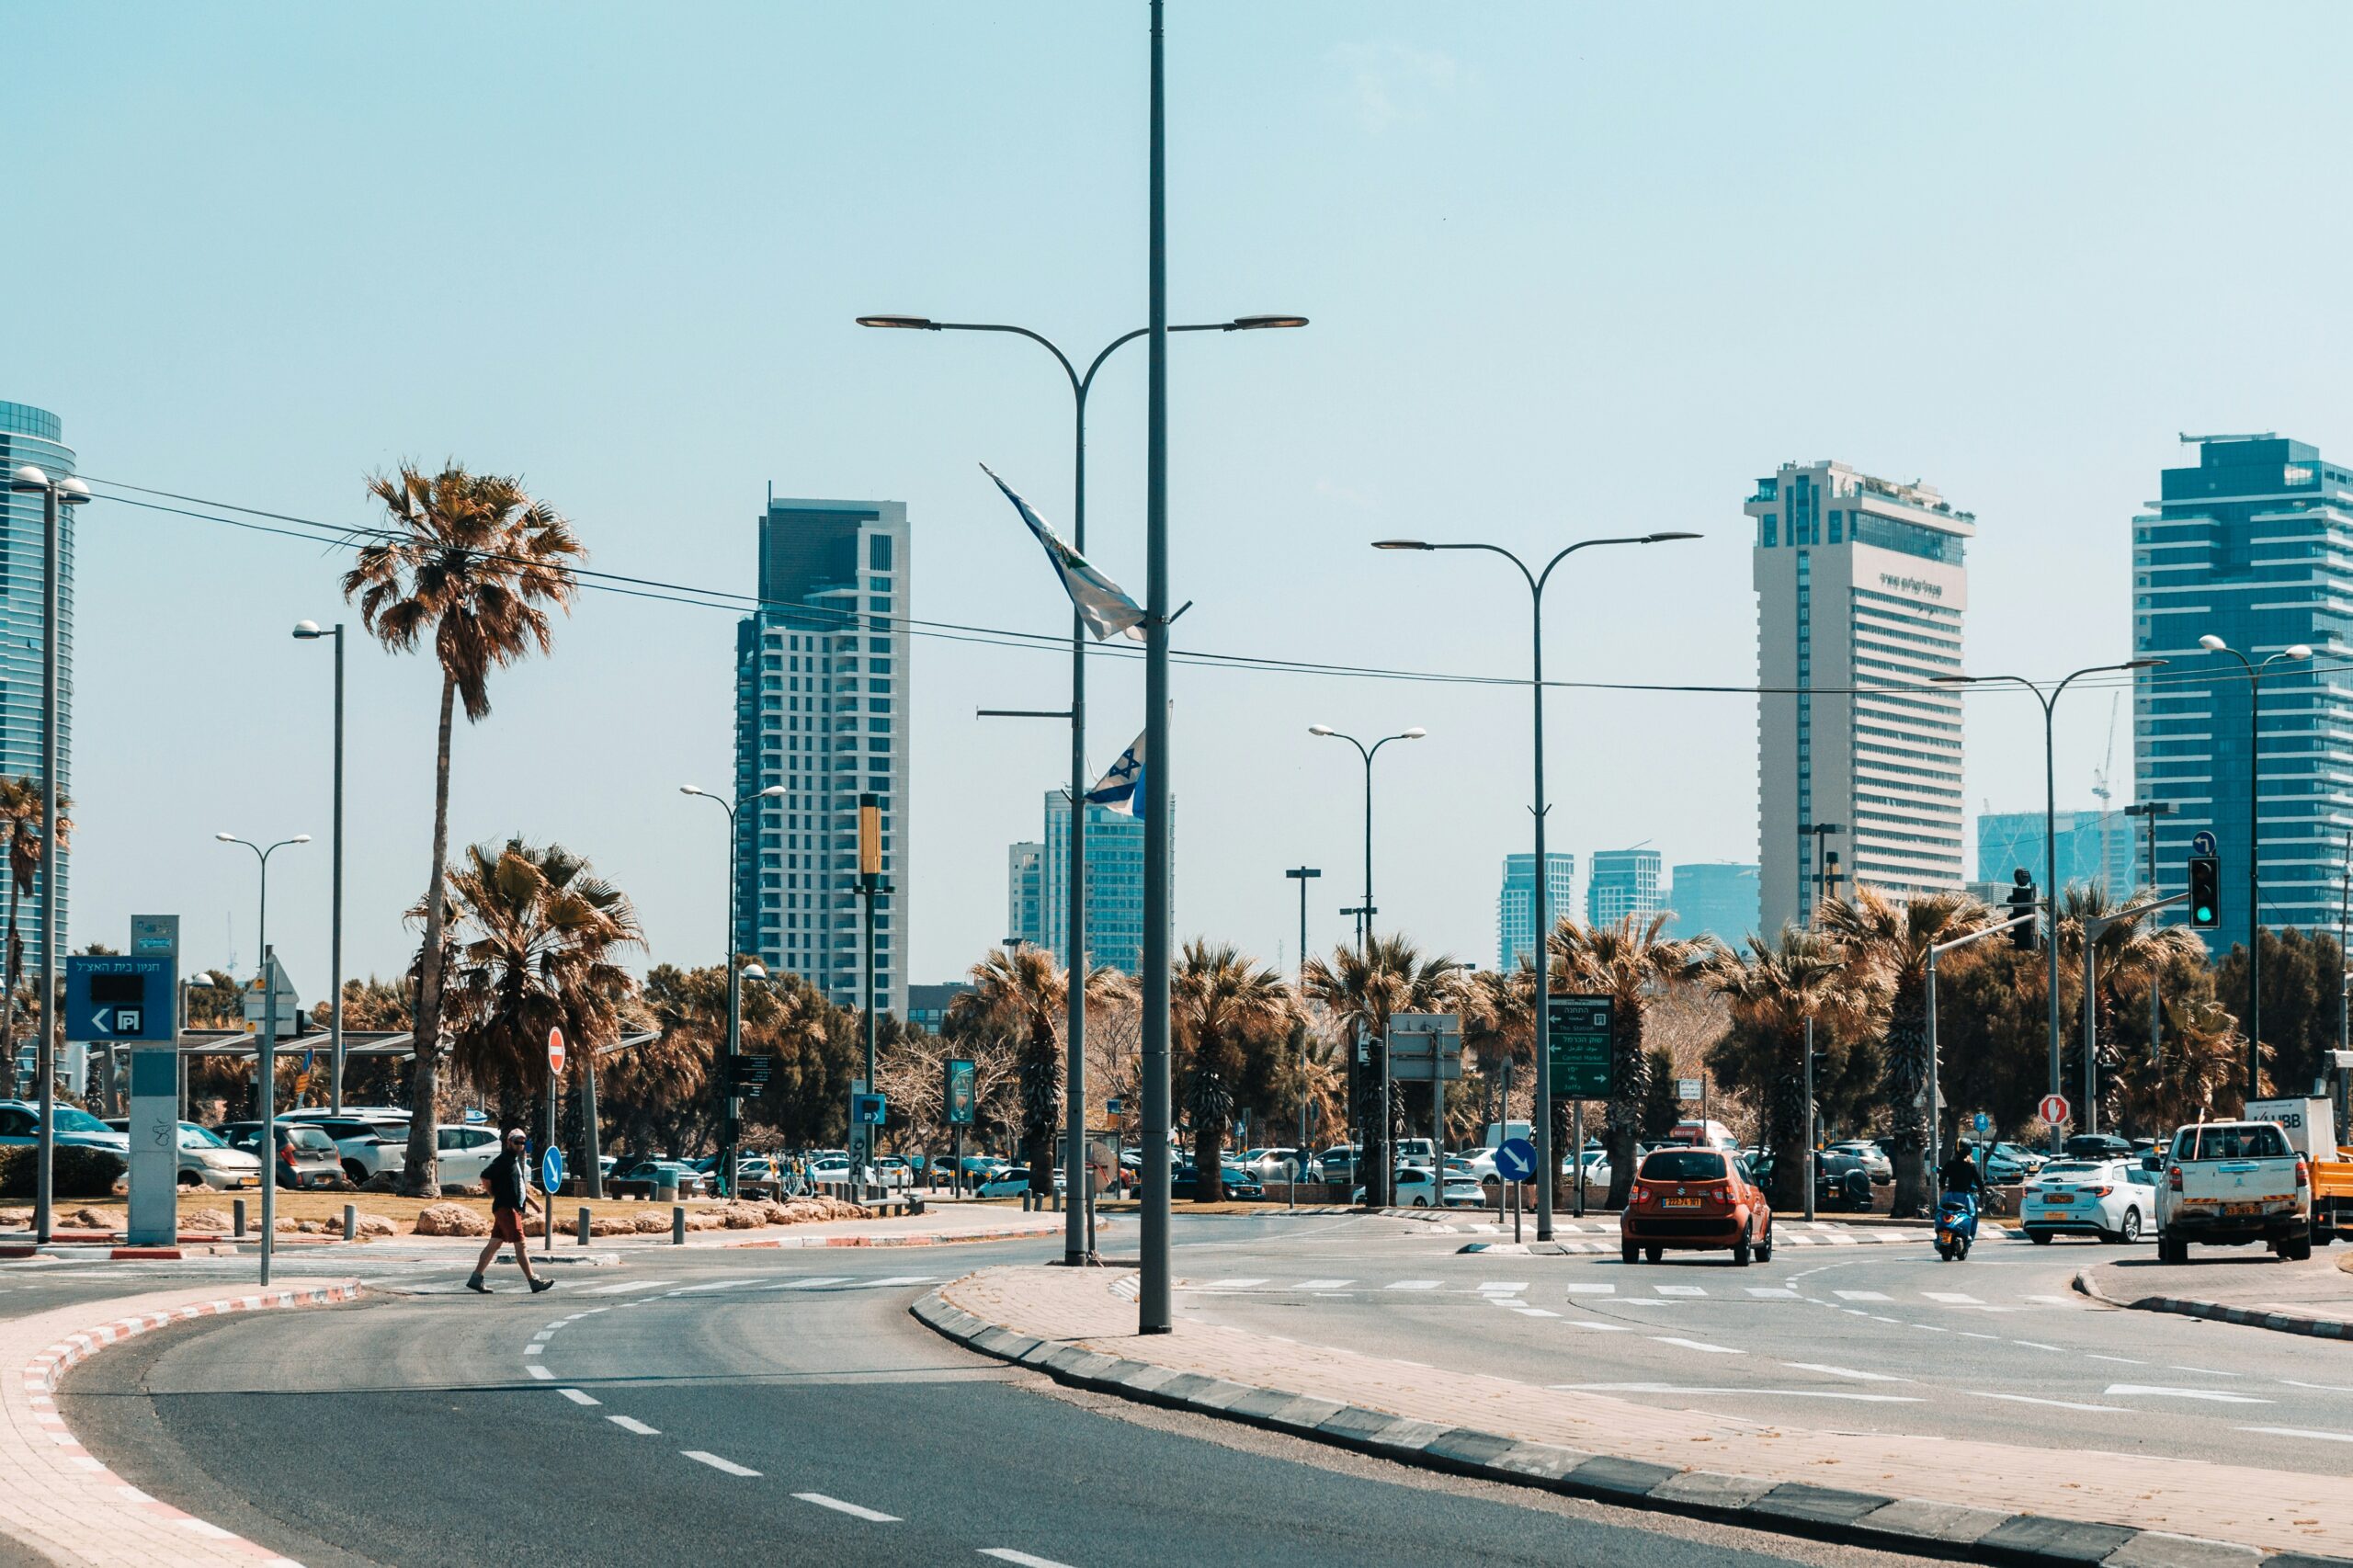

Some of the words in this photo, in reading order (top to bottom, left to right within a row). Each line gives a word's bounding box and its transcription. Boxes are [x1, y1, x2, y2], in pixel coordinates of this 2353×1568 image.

[113, 962, 133, 972] בית
[136, 962, 160, 973] חניון
[1589, 1036, 1603, 1044] שוק
